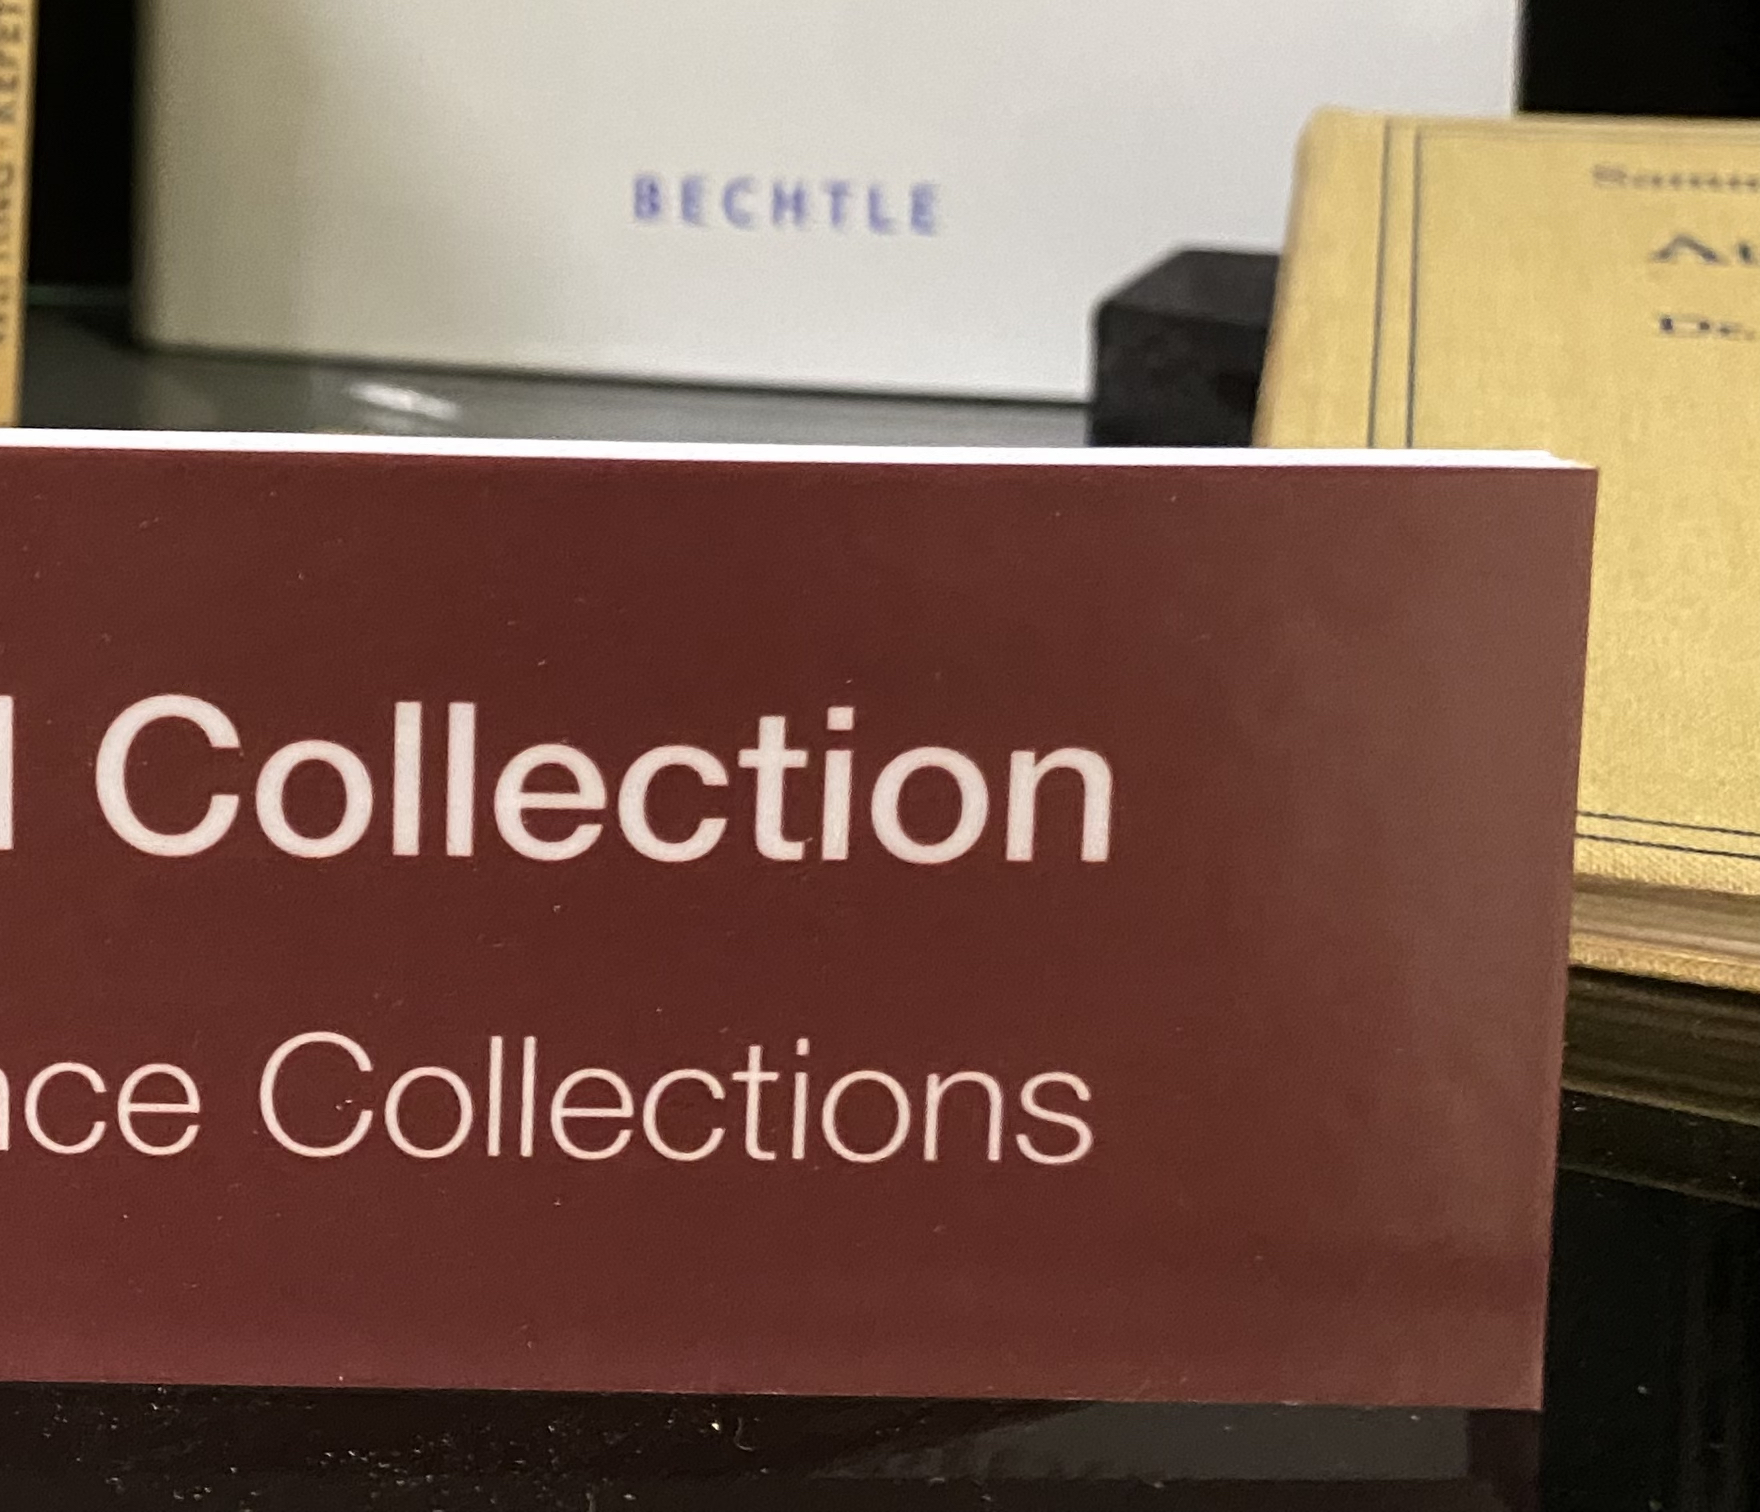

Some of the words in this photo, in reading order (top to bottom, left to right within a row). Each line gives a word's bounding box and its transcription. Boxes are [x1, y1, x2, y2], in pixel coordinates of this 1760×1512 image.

[632, 172, 938, 236] BECHTLE
[94, 694, 1115, 864] Collection
[260, 1032, 1095, 1166] Collections
